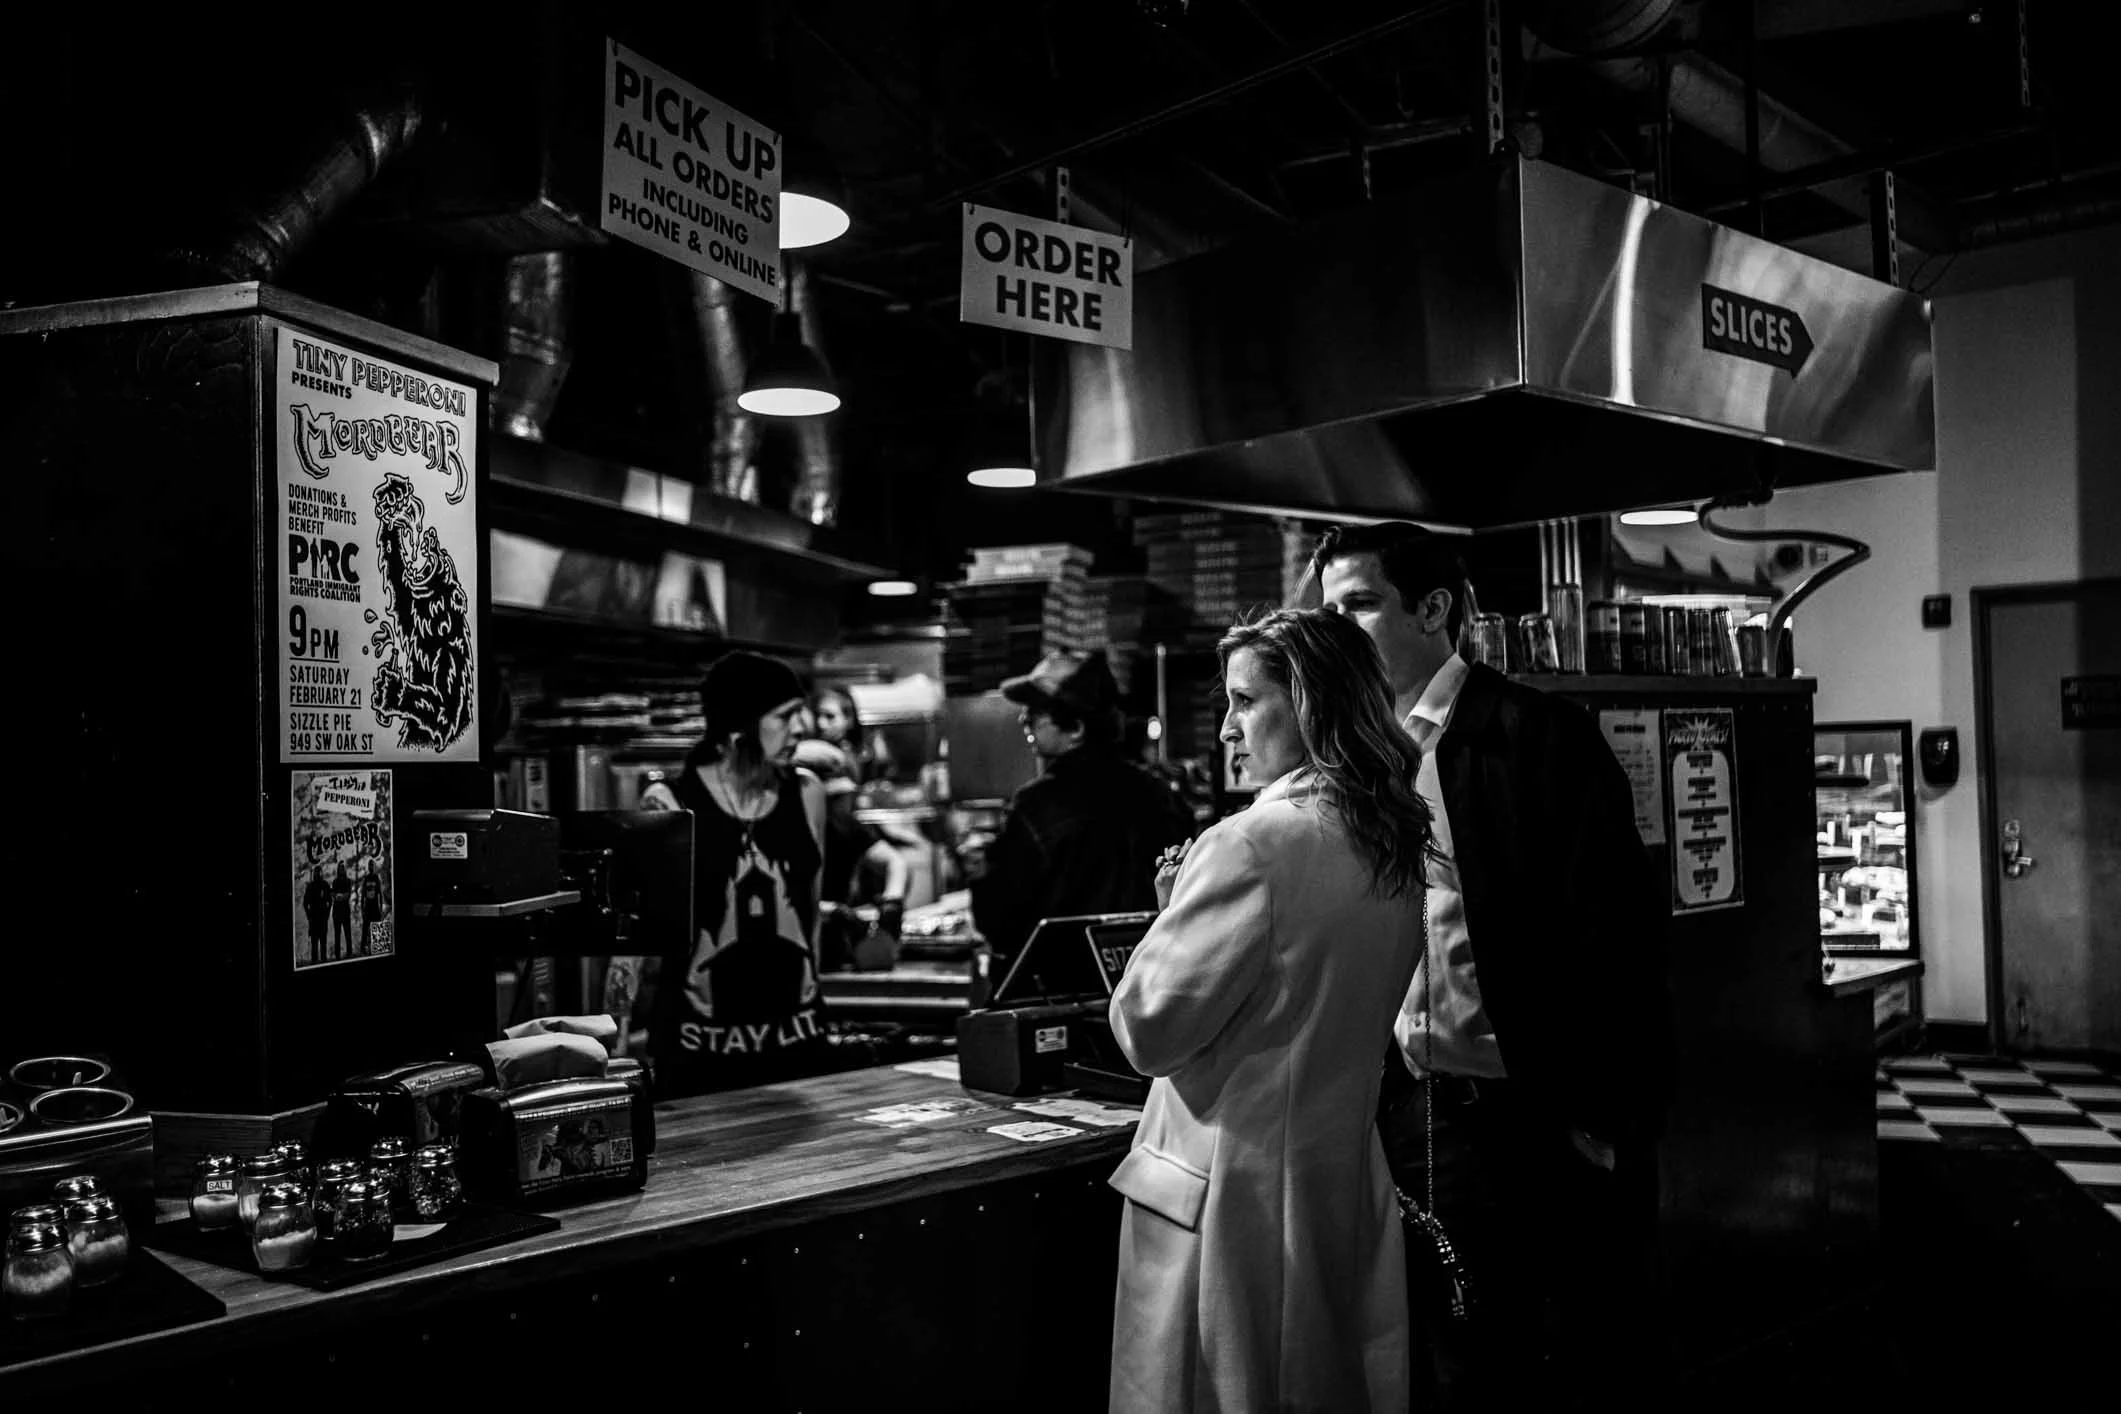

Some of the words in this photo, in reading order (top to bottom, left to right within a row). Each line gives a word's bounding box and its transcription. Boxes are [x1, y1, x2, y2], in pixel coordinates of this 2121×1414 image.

[615, 60, 711, 155] PICK
[726, 119, 776, 181] UP
[613, 122, 663, 170] ALL
[673, 151, 773, 224] ORDERS
[643, 178, 748, 245] INCLUDING
[609, 192, 681, 244] PHONE
[687, 230, 703, 254] &
[708, 240, 776, 286] ONLINE
[975, 221, 1122, 287] ORDER
[996, 275, 1102, 331] HERE
[1711, 297, 1793, 356] SLICES
[291, 371, 353, 399] PRESENTS
[293, 339, 348, 381] TINY
[351, 357, 466, 417] PEPPERONI
[289, 403, 469, 505] MORDBEAR
[288, 483, 338, 507] DONATIONS
[340, 494, 347, 508] &
[288, 499, 320, 519] MERCH
[322, 506, 357, 526] PROFITS
[288, 516, 325, 537] BENEFIT
[289, 576, 324, 588] PORTLAND
[324, 581, 360, 593] IMMIGRANT
[289, 585, 319, 599] RIGHTS
[320, 588, 361, 603] COALITION
[289, 664, 350, 685] SATURDAY
[289, 686, 347, 705] FEBRUARY
[350, 688, 362, 705] 21
[289, 712, 329, 732] SIZZLE
[333, 714, 352, 732] PIE
[289, 733, 311, 751] 949
[315, 733, 332, 751] SW
[336, 733, 357, 751] OAK
[361, 734, 374, 751] ST
[324, 791, 370, 808] PEPPERONI
[679, 1022, 771, 1054] STAY
[208, 1182, 231, 1191] SALT
